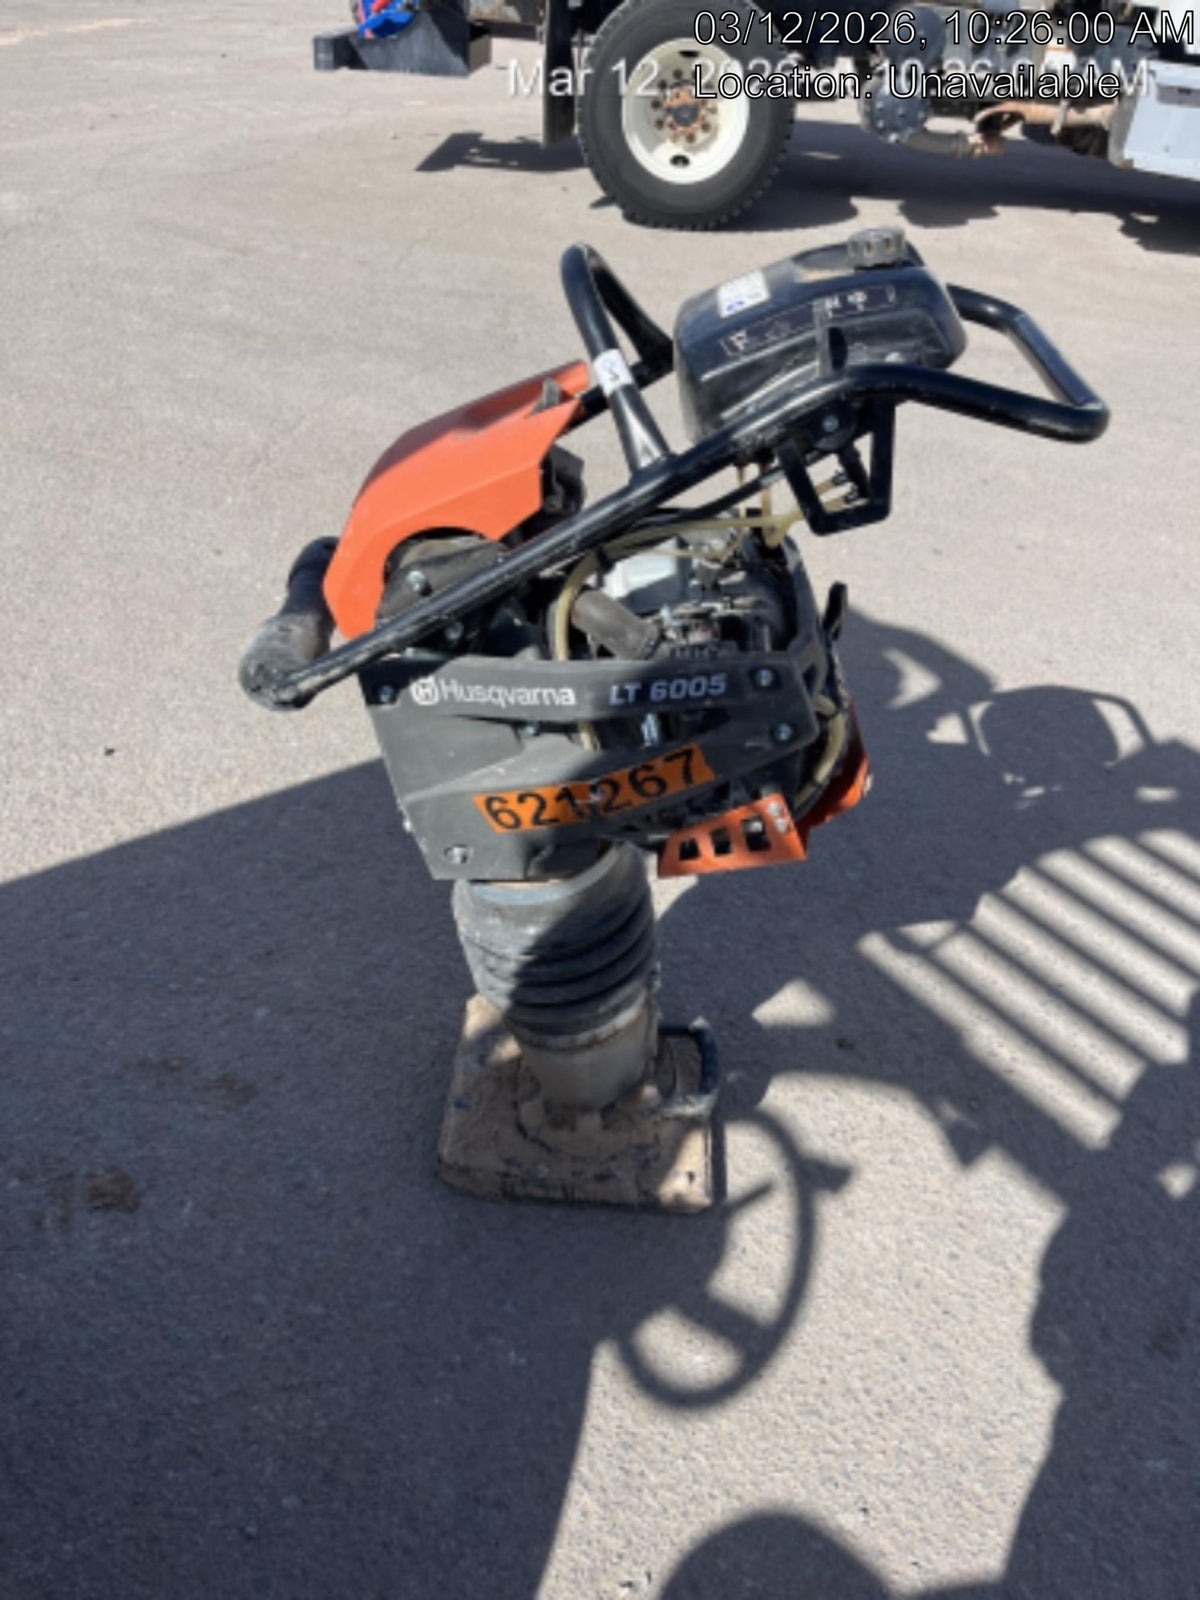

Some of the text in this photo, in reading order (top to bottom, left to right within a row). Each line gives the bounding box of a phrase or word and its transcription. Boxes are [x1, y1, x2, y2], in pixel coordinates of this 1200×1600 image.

[438, 676, 578, 709] Husqvarna
[608, 672, 728, 705] LT 6005
